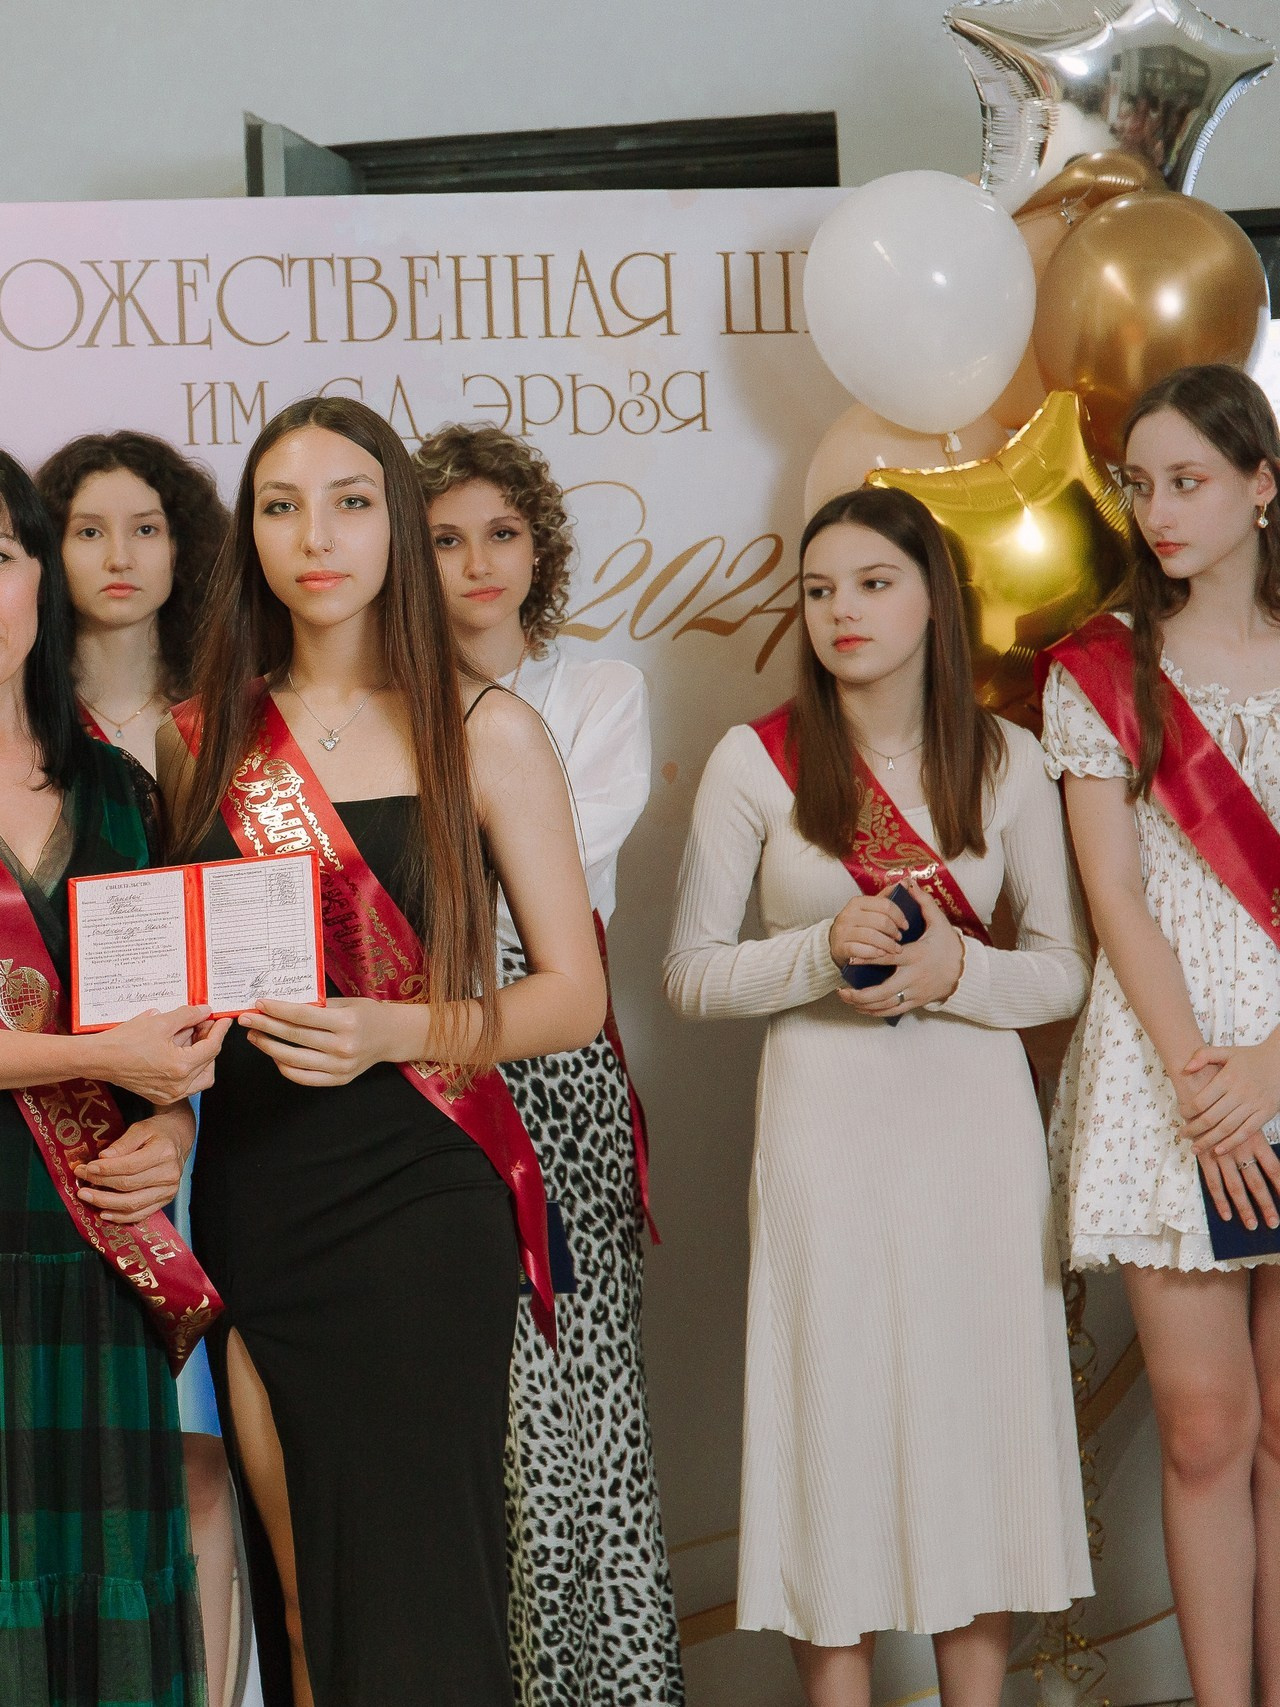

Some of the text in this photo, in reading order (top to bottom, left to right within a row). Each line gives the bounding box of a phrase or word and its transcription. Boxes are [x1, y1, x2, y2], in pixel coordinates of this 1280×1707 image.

[716, 251, 809, 334] Ш
[461, 368, 712, 437] ЭРЬЗЯ
[558, 533, 801, 674] 2024
